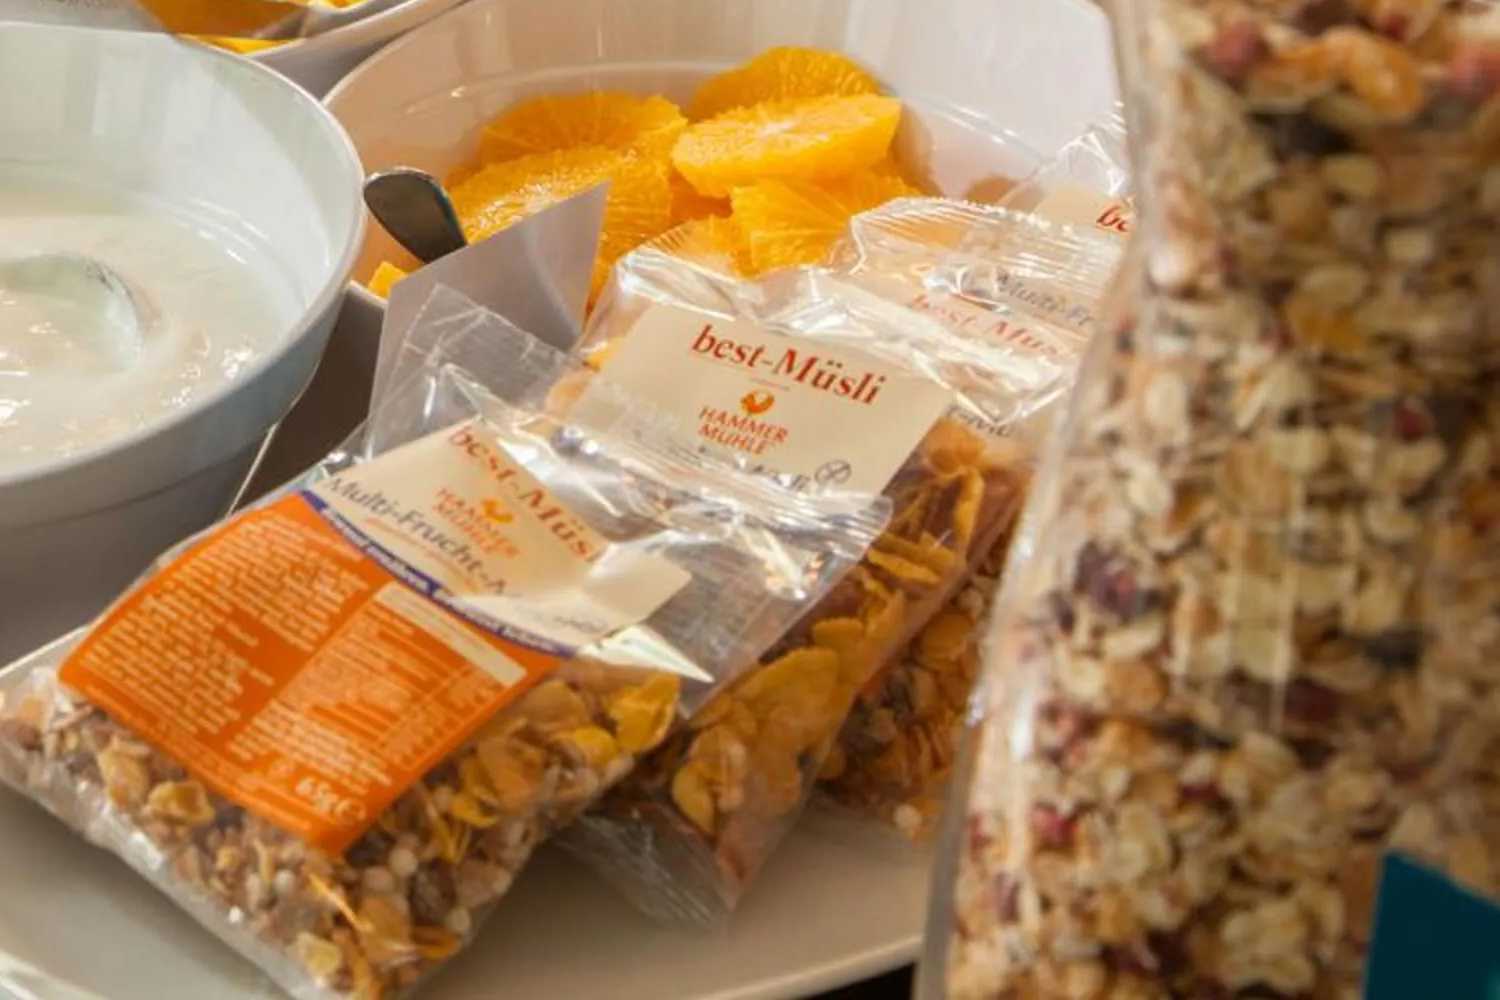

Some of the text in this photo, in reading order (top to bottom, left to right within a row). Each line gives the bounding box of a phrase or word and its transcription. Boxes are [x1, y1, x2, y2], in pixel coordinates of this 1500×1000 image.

[690, 323, 886, 405] best-Müsli
[698, 404, 789, 444] HAMMER
[448, 424, 601, 566] best-Müsl
